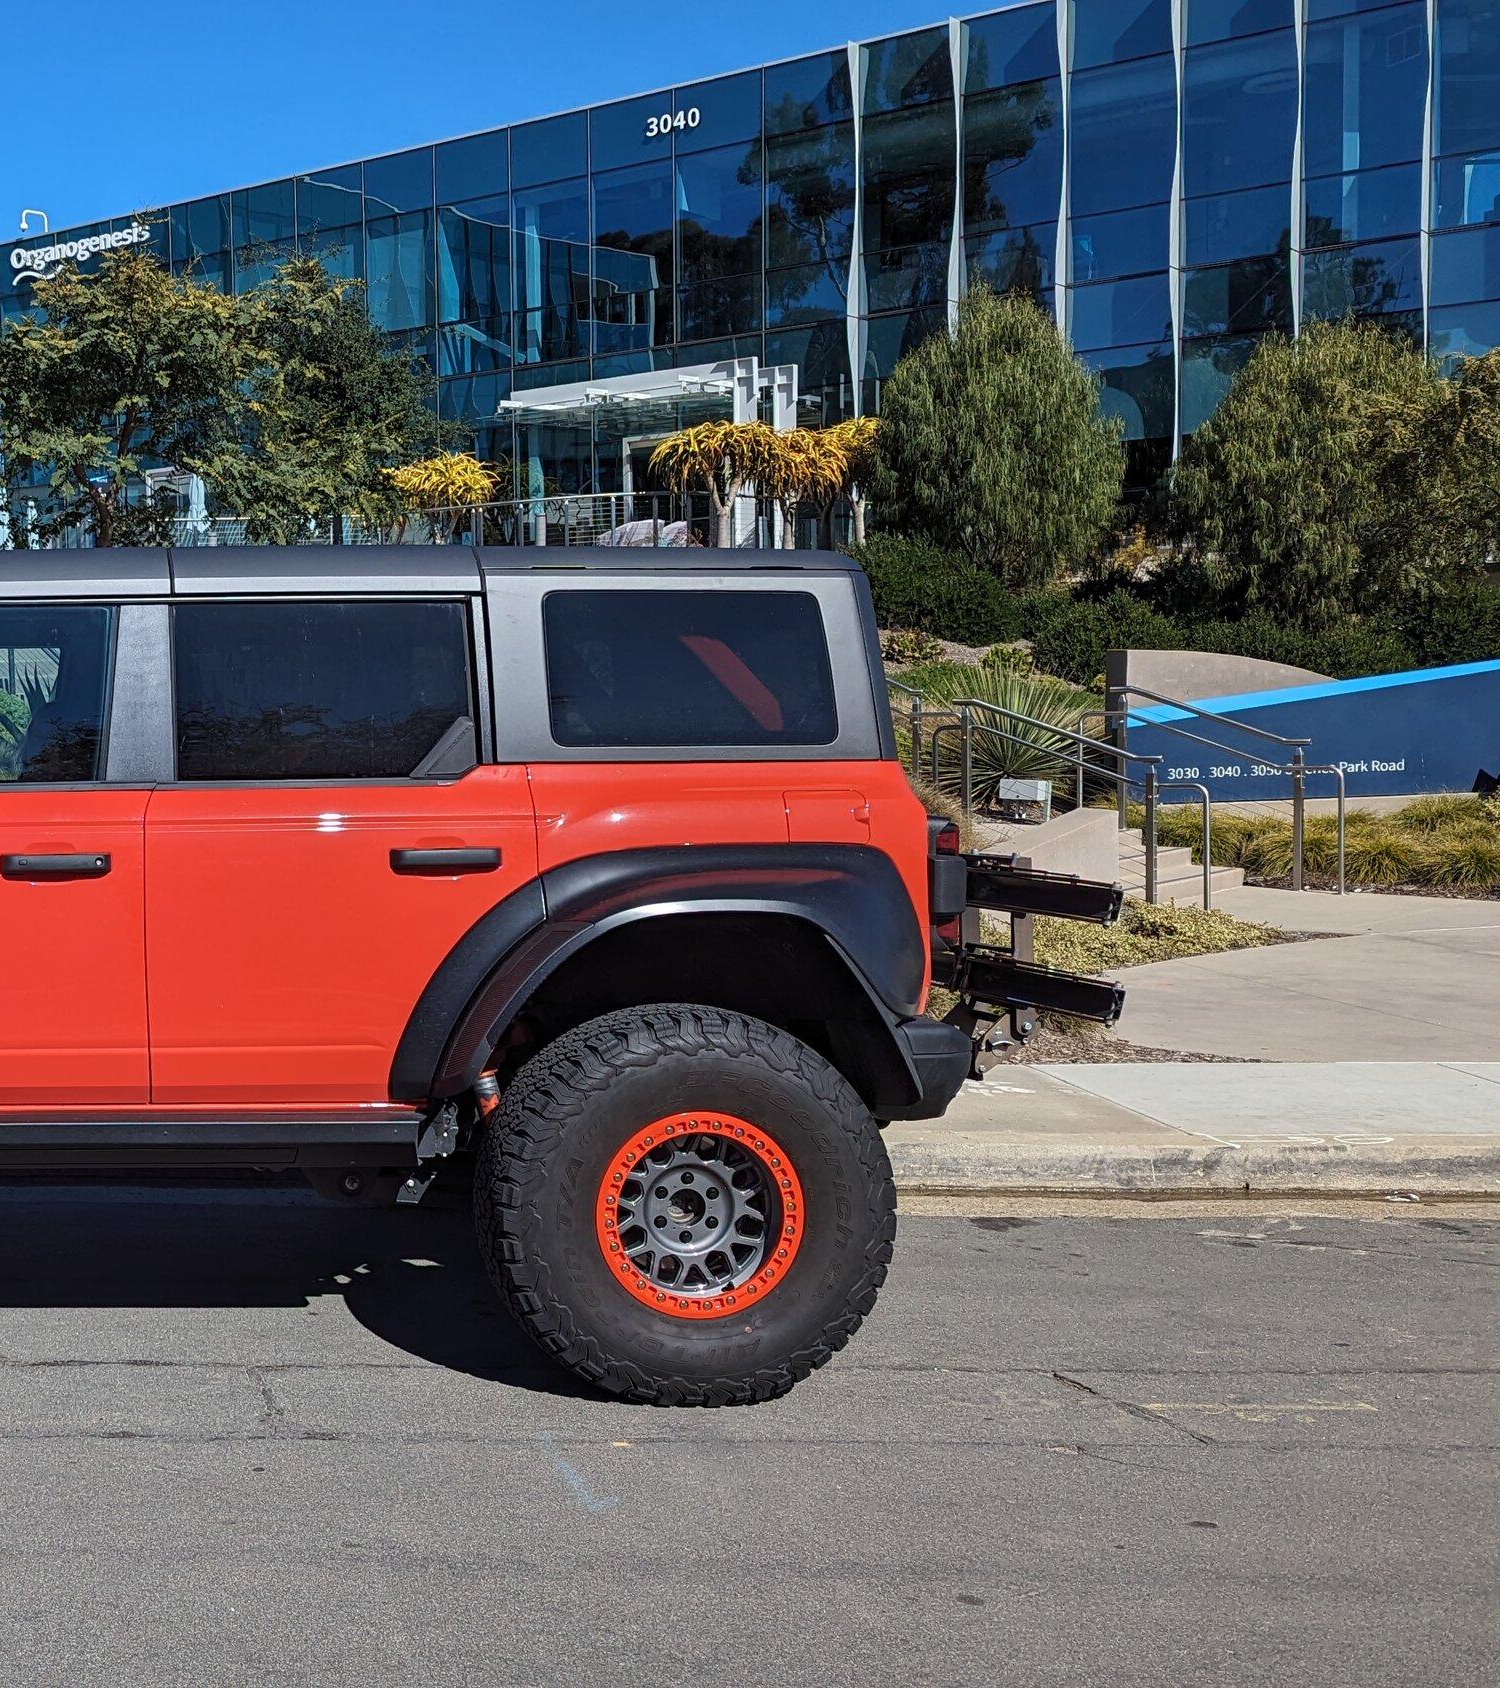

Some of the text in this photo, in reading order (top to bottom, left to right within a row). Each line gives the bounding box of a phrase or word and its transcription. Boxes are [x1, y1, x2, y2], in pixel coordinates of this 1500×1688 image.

[645, 107, 700, 137] 3040
[10, 222, 150, 270] Organogenesis
[1167, 767, 1200, 780] 3030
[1208, 765, 1241, 778] 3040
[1339, 760, 1369, 773] Park
[1371, 758, 1405, 772] Road
